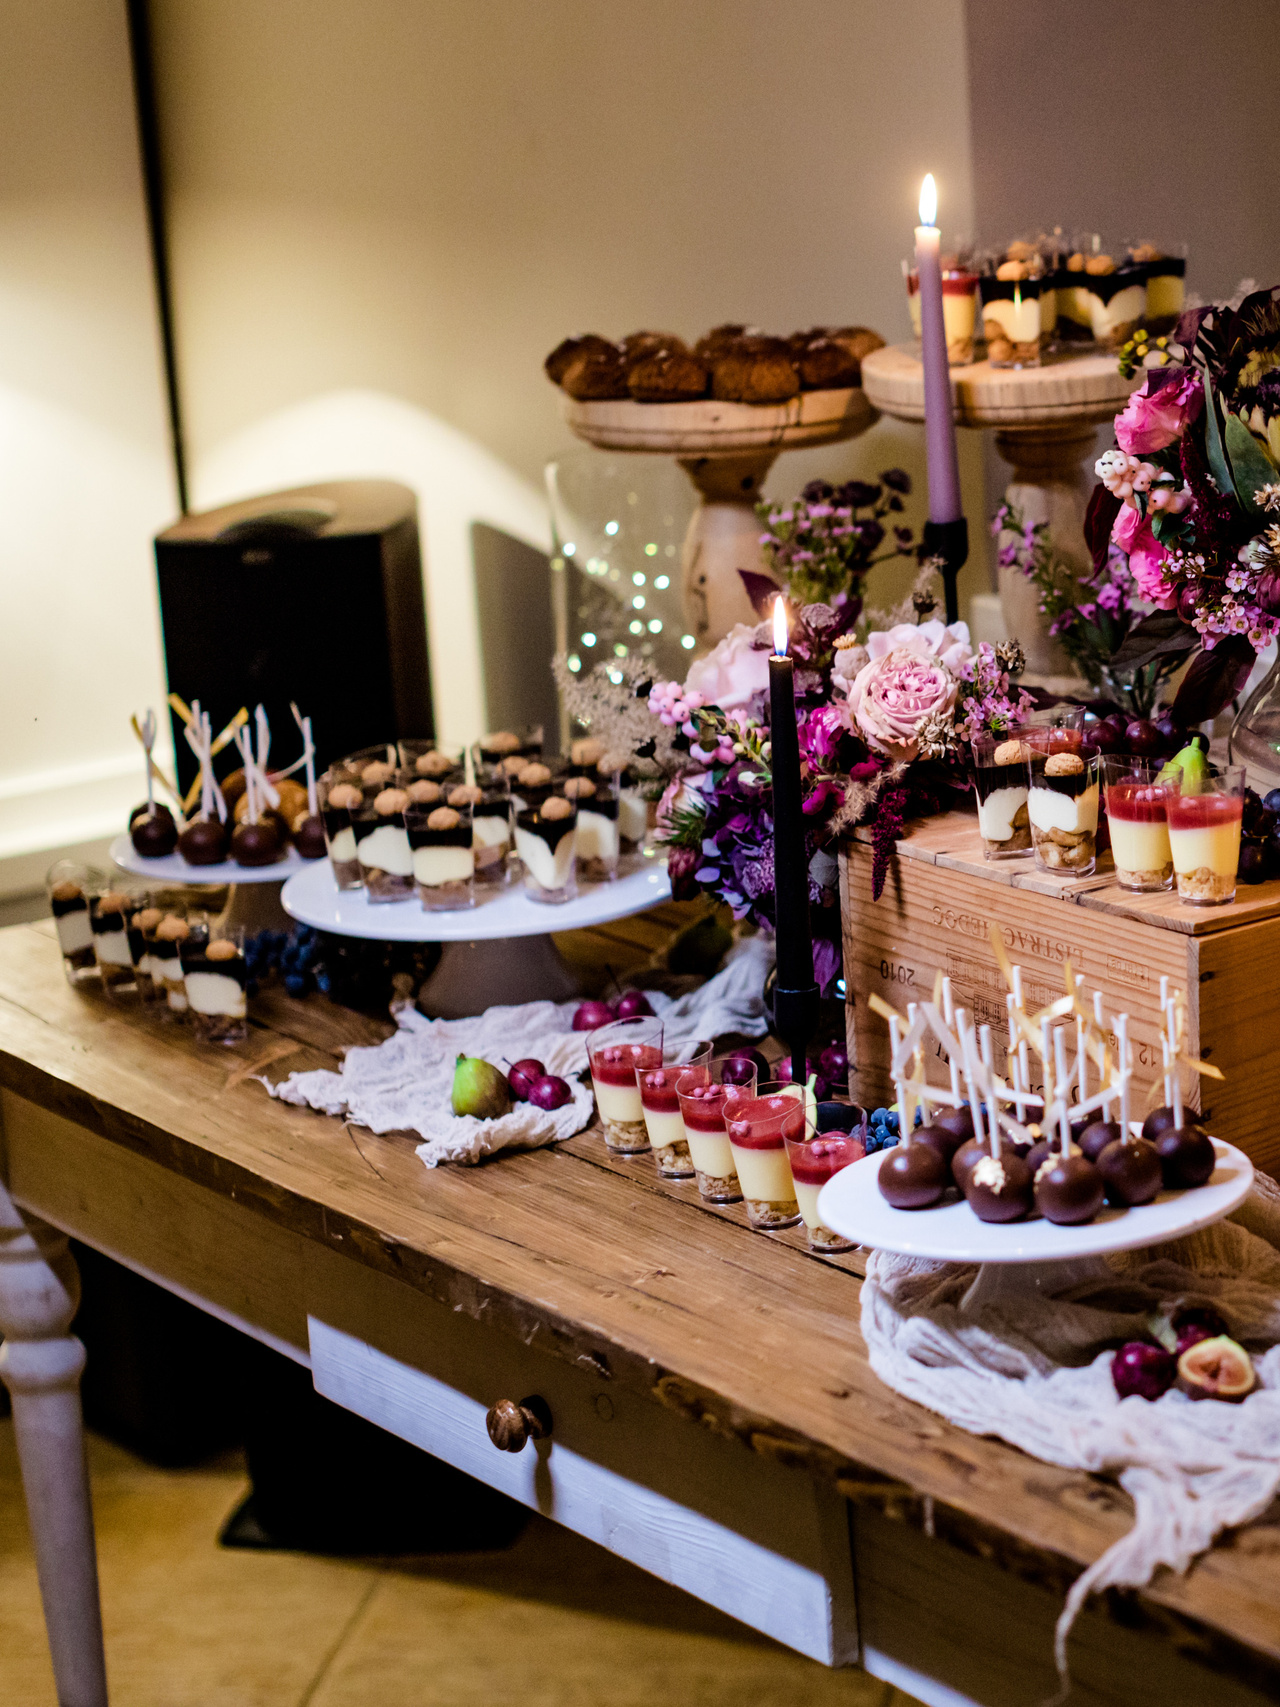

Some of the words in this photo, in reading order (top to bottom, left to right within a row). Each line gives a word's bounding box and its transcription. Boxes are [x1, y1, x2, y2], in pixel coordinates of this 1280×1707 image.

[1003, 927, 1085, 969] LISTRAC
[880, 960, 915, 987] 2010
[1138, 1042, 1157, 1068] 12
